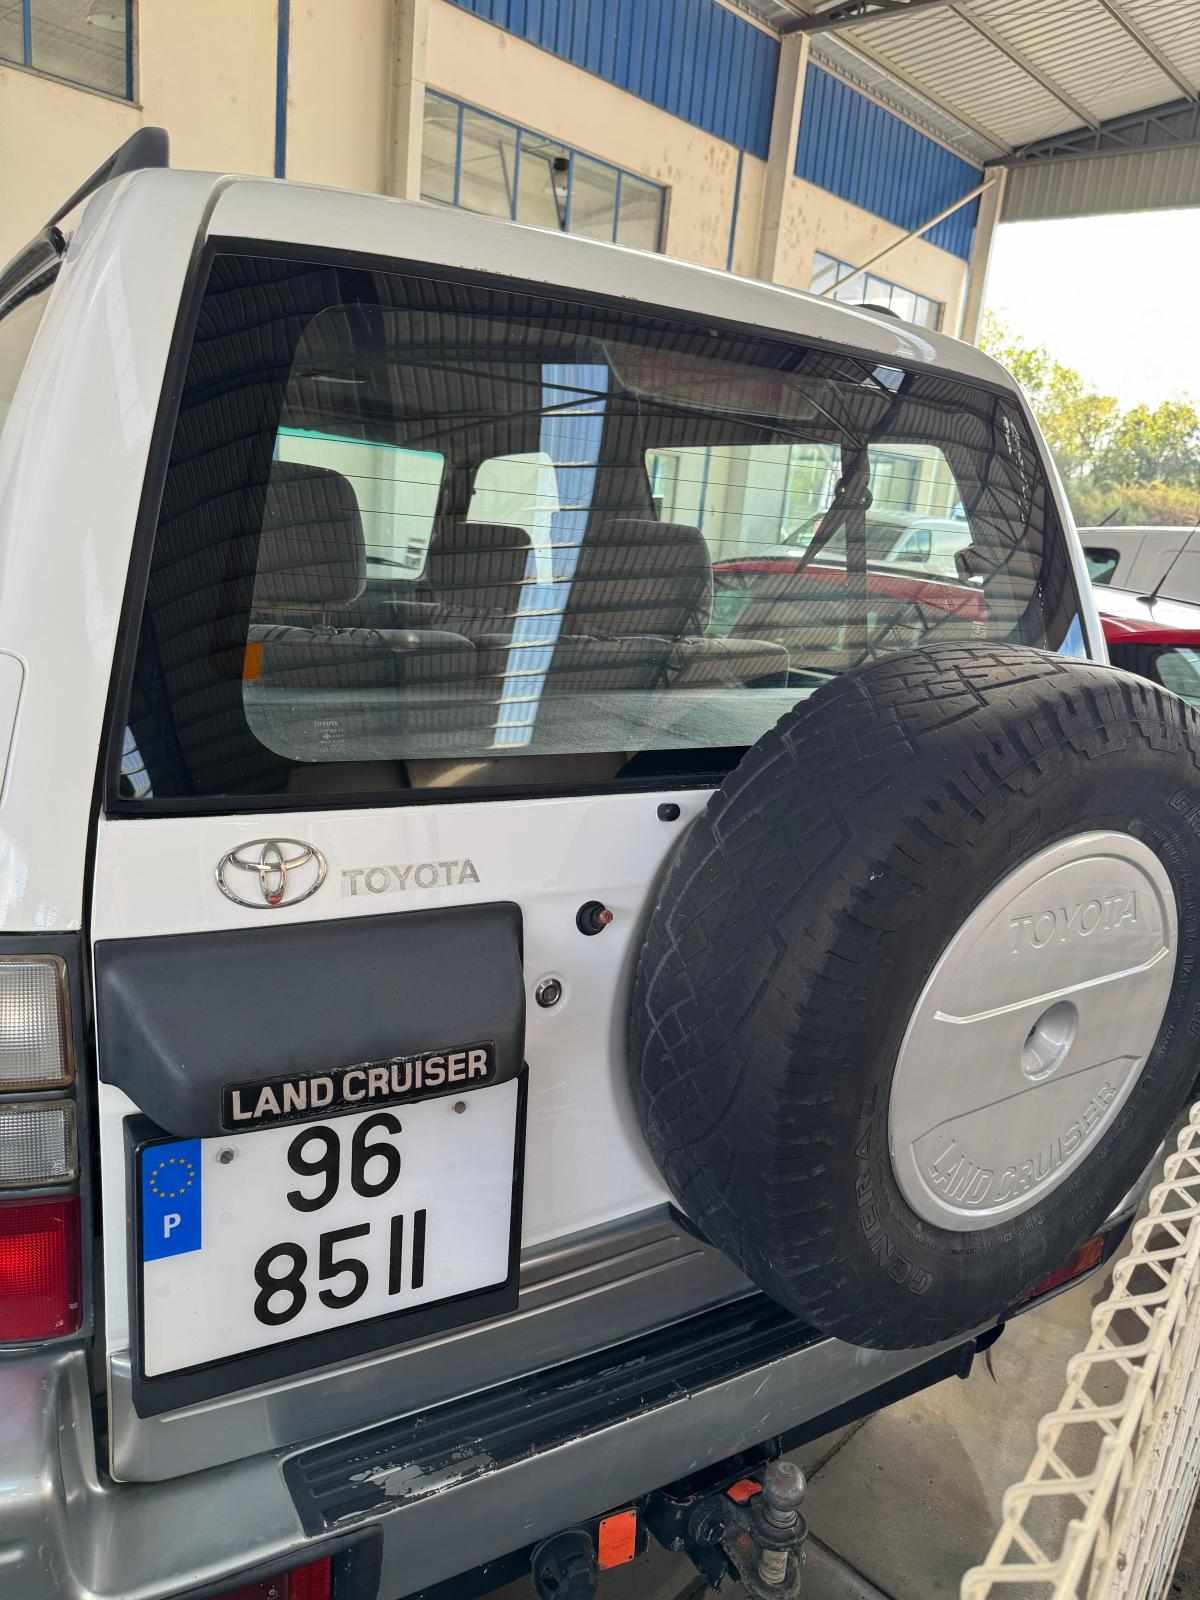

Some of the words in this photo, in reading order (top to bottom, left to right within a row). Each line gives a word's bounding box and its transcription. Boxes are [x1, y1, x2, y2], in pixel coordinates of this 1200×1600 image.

[341, 859, 480, 896] TOYOTA
[1009, 890, 1136, 954] TOYOTA
[231, 1077, 334, 1121] LAND
[342, 1049, 488, 1102] CRUISER
[286, 1113, 403, 1213] 96
[928, 1136, 994, 1204] LAND
[992, 1082, 1117, 1202] CRUISER
[163, 1213, 181, 1239] P
